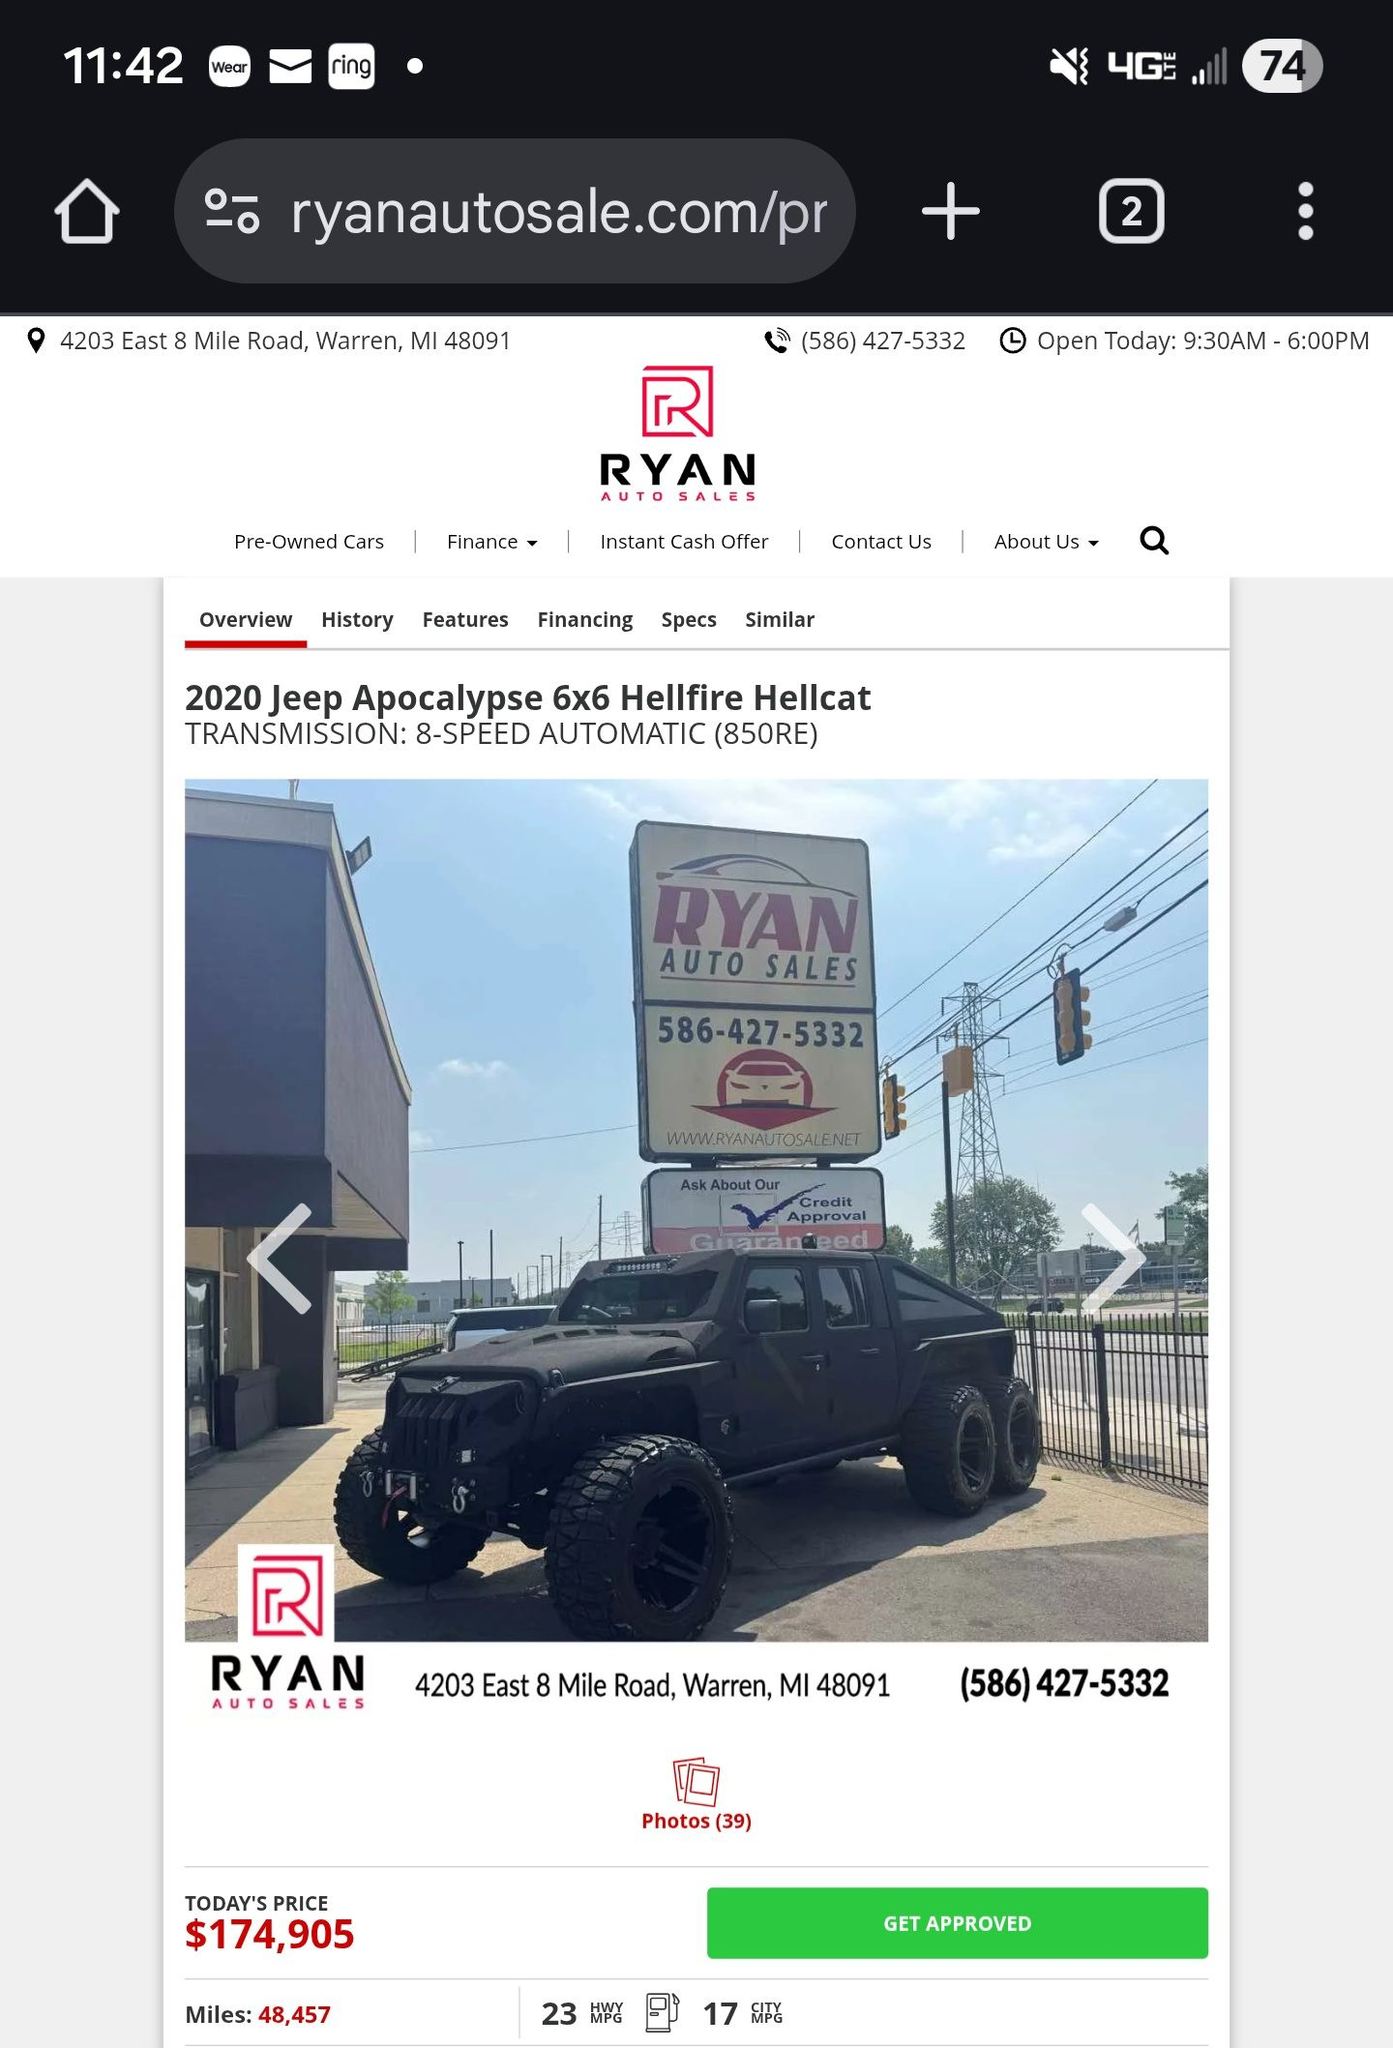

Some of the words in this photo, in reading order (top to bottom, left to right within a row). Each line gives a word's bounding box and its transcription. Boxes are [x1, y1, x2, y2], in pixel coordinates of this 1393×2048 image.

[64, 46, 184, 84] 11:42
[211, 61, 248, 74] Wear
[331, 54, 372, 80] ring
[1107, 51, 1163, 80] 4G
[1163, 51, 1177, 80] LTE
[1261, 50, 1307, 81] 74
[293, 187, 828, 246] ryanautosale.com/pr
[1121, 196, 1143, 226] 2
[60, 331, 114, 350] 4203
[122, 331, 168, 350] East
[174, 331, 187, 350] 8
[195, 330, 240, 350] Mile
[248, 330, 309, 353] Road,
[315, 331, 403, 353] Warren,
[411, 331, 437, 350] MI
[444, 331, 508, 350] 48091
[801, 331, 856, 354] (586)
[862, 331, 966, 350] 427-5332
[1037, 331, 1097, 355] Open
[1104, 331, 1176, 355] Today:
[1183, 331, 1266, 350] 9:30AM
[1287, 331, 1369, 350] 6:00PM
[600, 453, 756, 486] RYAN
[600, 491, 663, 502] AUTO
[678, 491, 756, 502] SALES
[235, 533, 337, 550] Pre-Owned
[343, 533, 385, 550] Cars
[448, 533, 518, 550] Finance
[601, 533, 666, 550] Instant
[671, 533, 715, 550] Cash
[721, 533, 770, 550] Offer
[831, 533, 904, 550] Contact
[908, 533, 932, 550] Us
[994, 533, 1051, 550] About
[1056, 533, 1080, 550] Us
[199, 610, 293, 628] Overview
[322, 610, 395, 633] History
[423, 611, 509, 628] Features
[538, 610, 634, 633] Financing
[661, 611, 717, 633] Specs
[745, 610, 816, 628] Similar
[185, 684, 262, 711] 2020
[268, 684, 343, 720] Jeep
[351, 683, 543, 720] Apocalypse
[552, 684, 610, 711] 6x6
[621, 683, 743, 711] Hellfire
[754, 683, 872, 711] Hellcat
[185, 721, 406, 745] TRANSMISSION:
[416, 721, 531, 745] 8-SPEED
[538, 721, 706, 745] AUTOMATIC
[714, 721, 818, 750] (850RE)
[653, 885, 859, 954] RYAN
[660, 948, 744, 976] AUTO
[766, 954, 858, 981] SALES
[658, 1016, 864, 1047] 586-427-5332
[667, 1131, 862, 1148] WWW.RYANAUTOSALE.NET
[681, 1179, 707, 1191] Ask
[710, 1179, 752, 1191] About
[755, 1179, 780, 1191] Our
[800, 1197, 853, 1208] Credit
[786, 1211, 866, 1224] Approval
[690, 1230, 868, 1250] Guaraneed
[642, 1812, 711, 1830] Photos
[715, 1812, 752, 1833] (39)
[184, 1895, 268, 1912] TODAY'S
[273, 1895, 328, 1912] PRICE
[883, 1915, 921, 1932] GET
[925, 1915, 1032, 1932] APPROVED
[185, 1917, 355, 1955] $174,905
[186, 2004, 252, 2024] Miles:
[257, 2004, 331, 2027] 48,457
[541, 2001, 577, 2026] 23
[590, 2001, 624, 2013] HWY
[590, 2012, 623, 2024] MPG
[703, 2001, 738, 2026] 17
[750, 2001, 782, 2013] CITY
[751, 2012, 783, 2024] MPG
